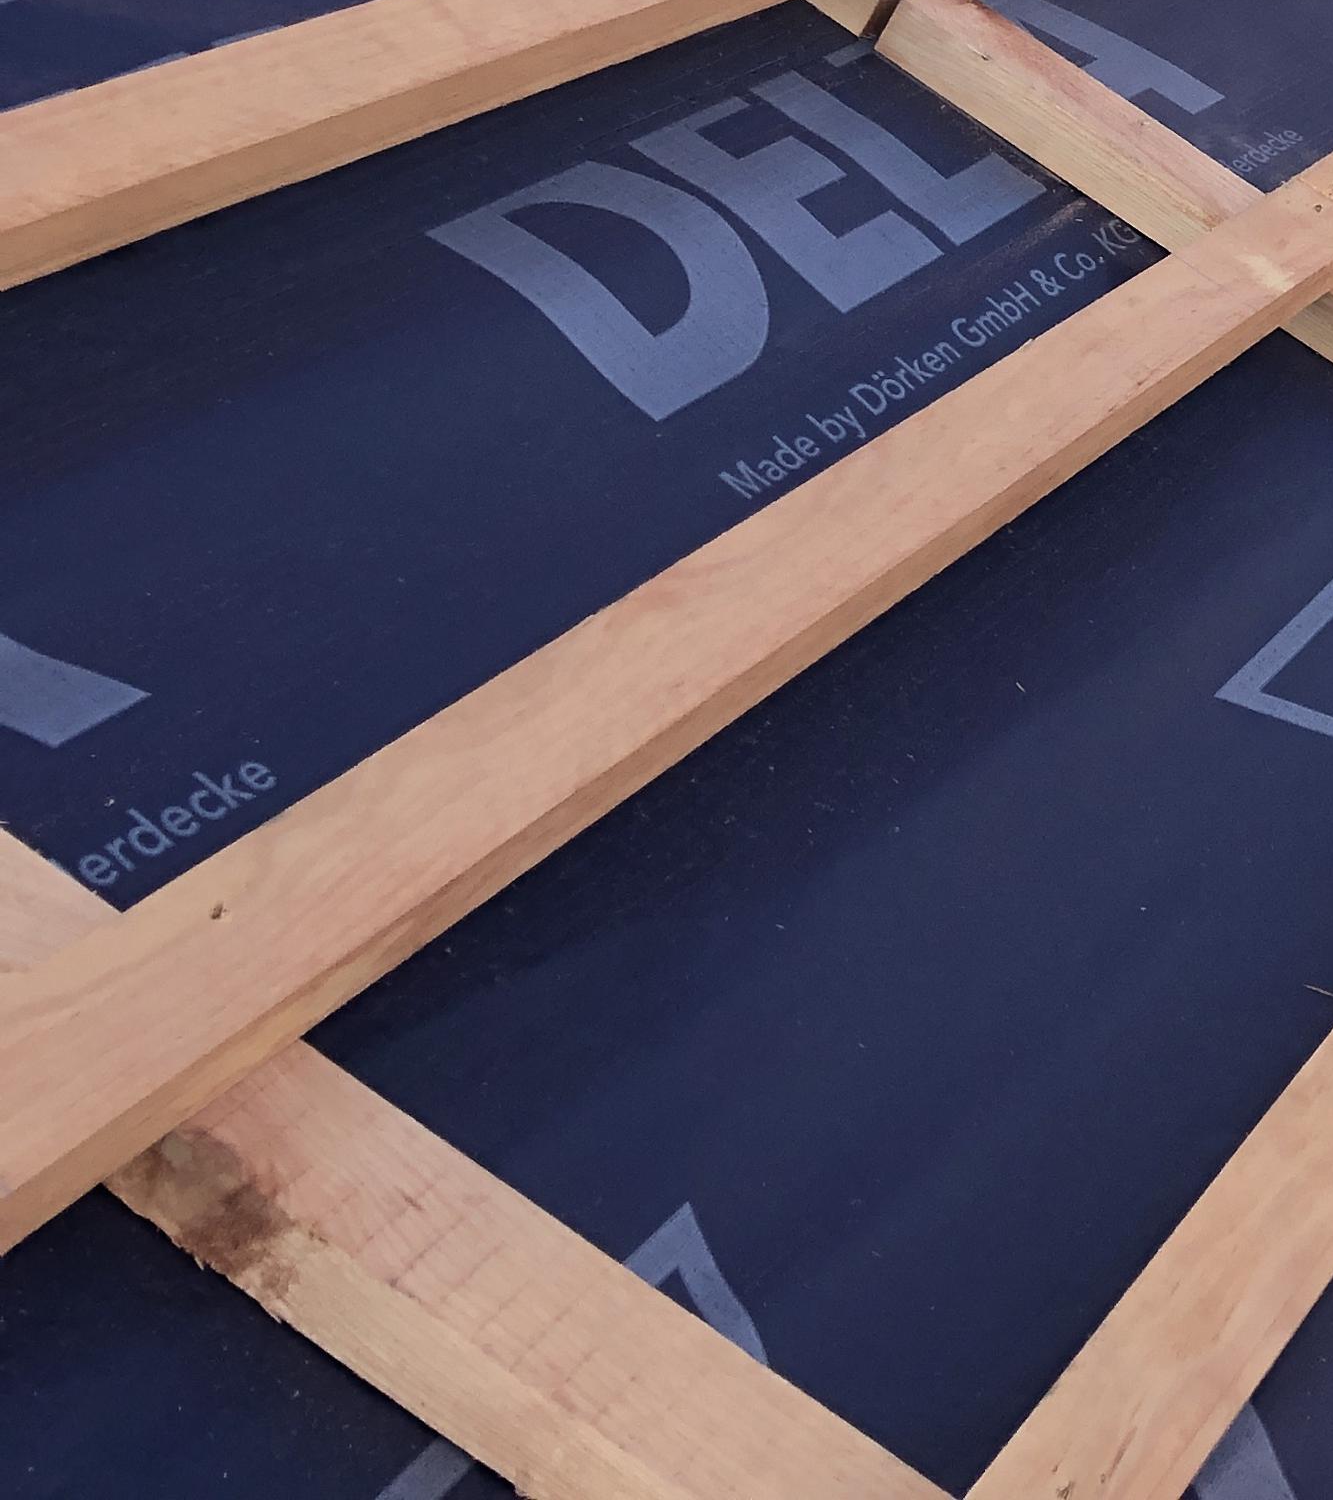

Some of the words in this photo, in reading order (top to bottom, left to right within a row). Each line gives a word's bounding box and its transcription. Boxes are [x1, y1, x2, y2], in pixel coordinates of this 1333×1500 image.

[718, 435, 821, 500] Made
[806, 404, 867, 441] by
[849, 340, 962, 417] Dörken
[950, 283, 1042, 349] GmbH
[1033, 267, 1067, 298] &
[1053, 249, 1106, 282] Co.
[1101, 217, 1143, 258] KG
[64, 760, 279, 887] erdecke
